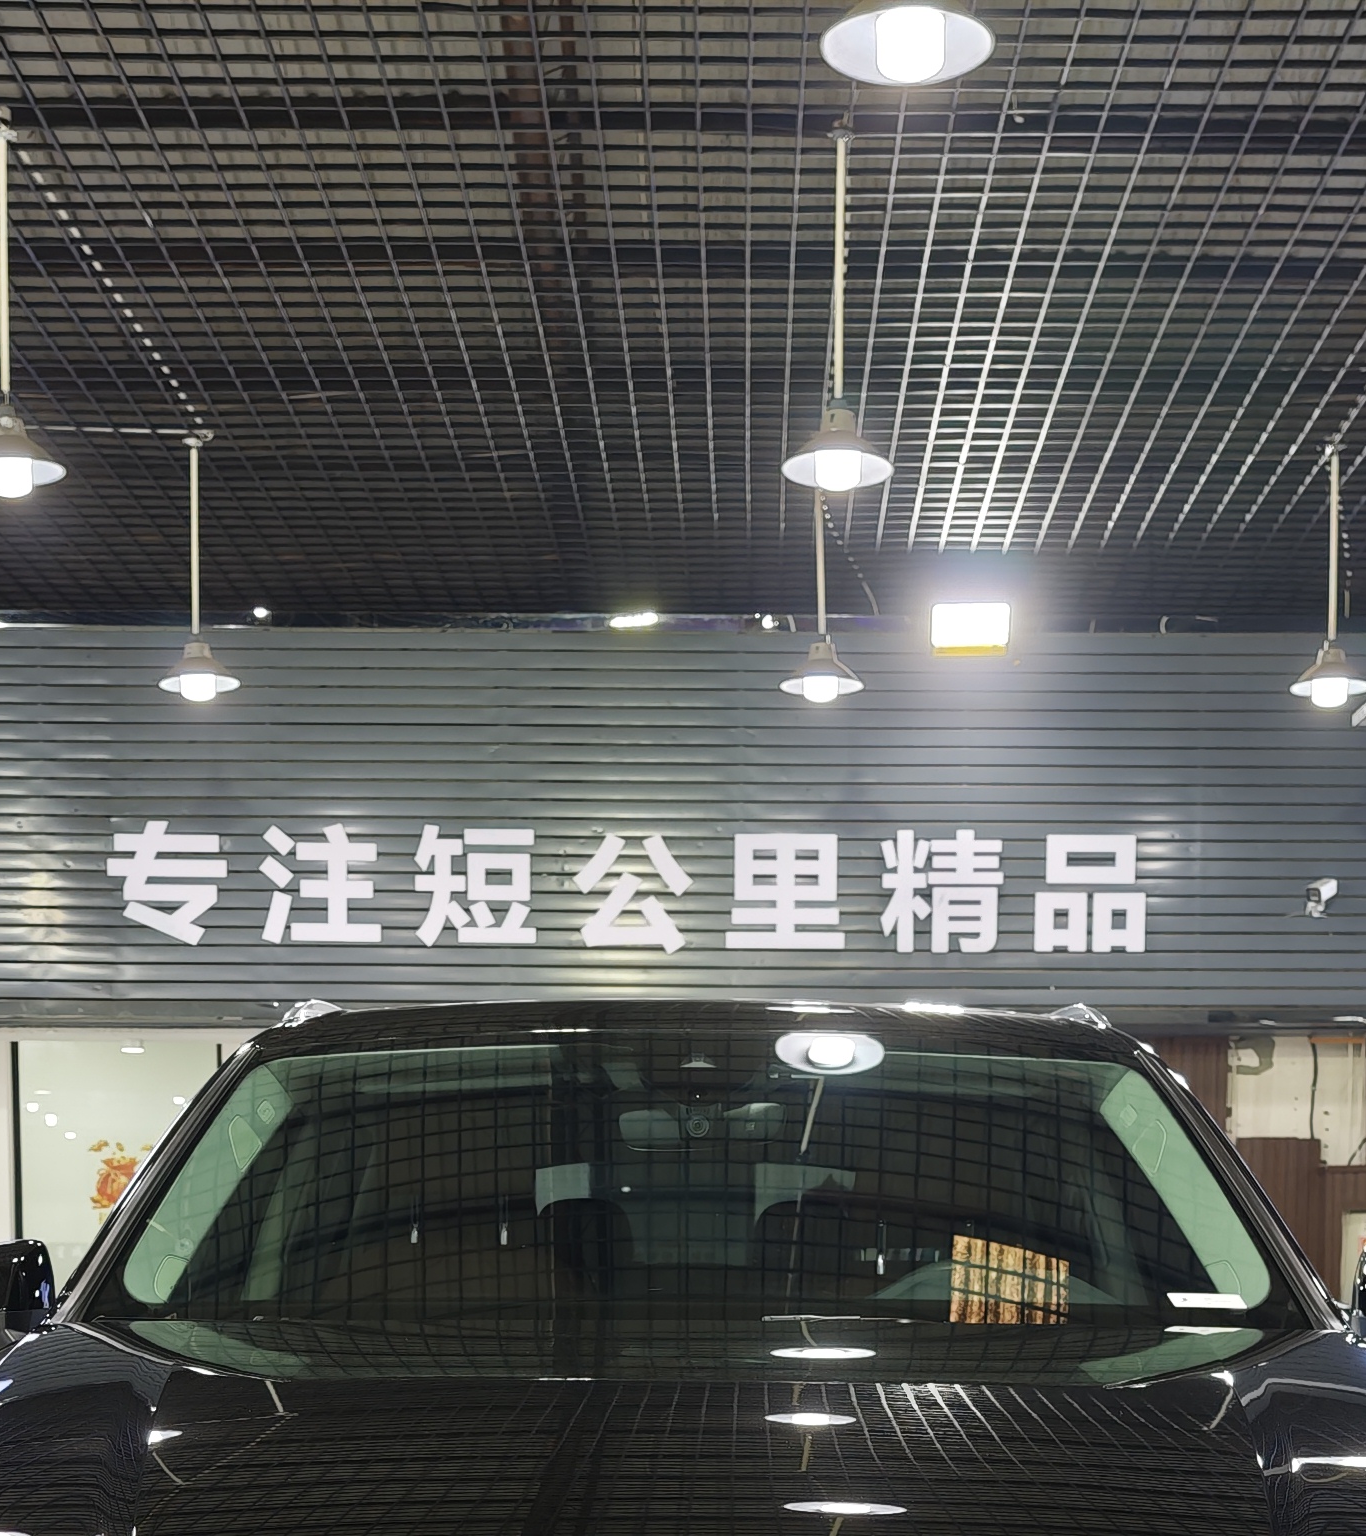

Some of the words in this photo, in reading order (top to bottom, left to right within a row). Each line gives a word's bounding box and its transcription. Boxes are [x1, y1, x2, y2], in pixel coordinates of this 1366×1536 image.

[105, 819, 1148, 956] 专注短公里精品
